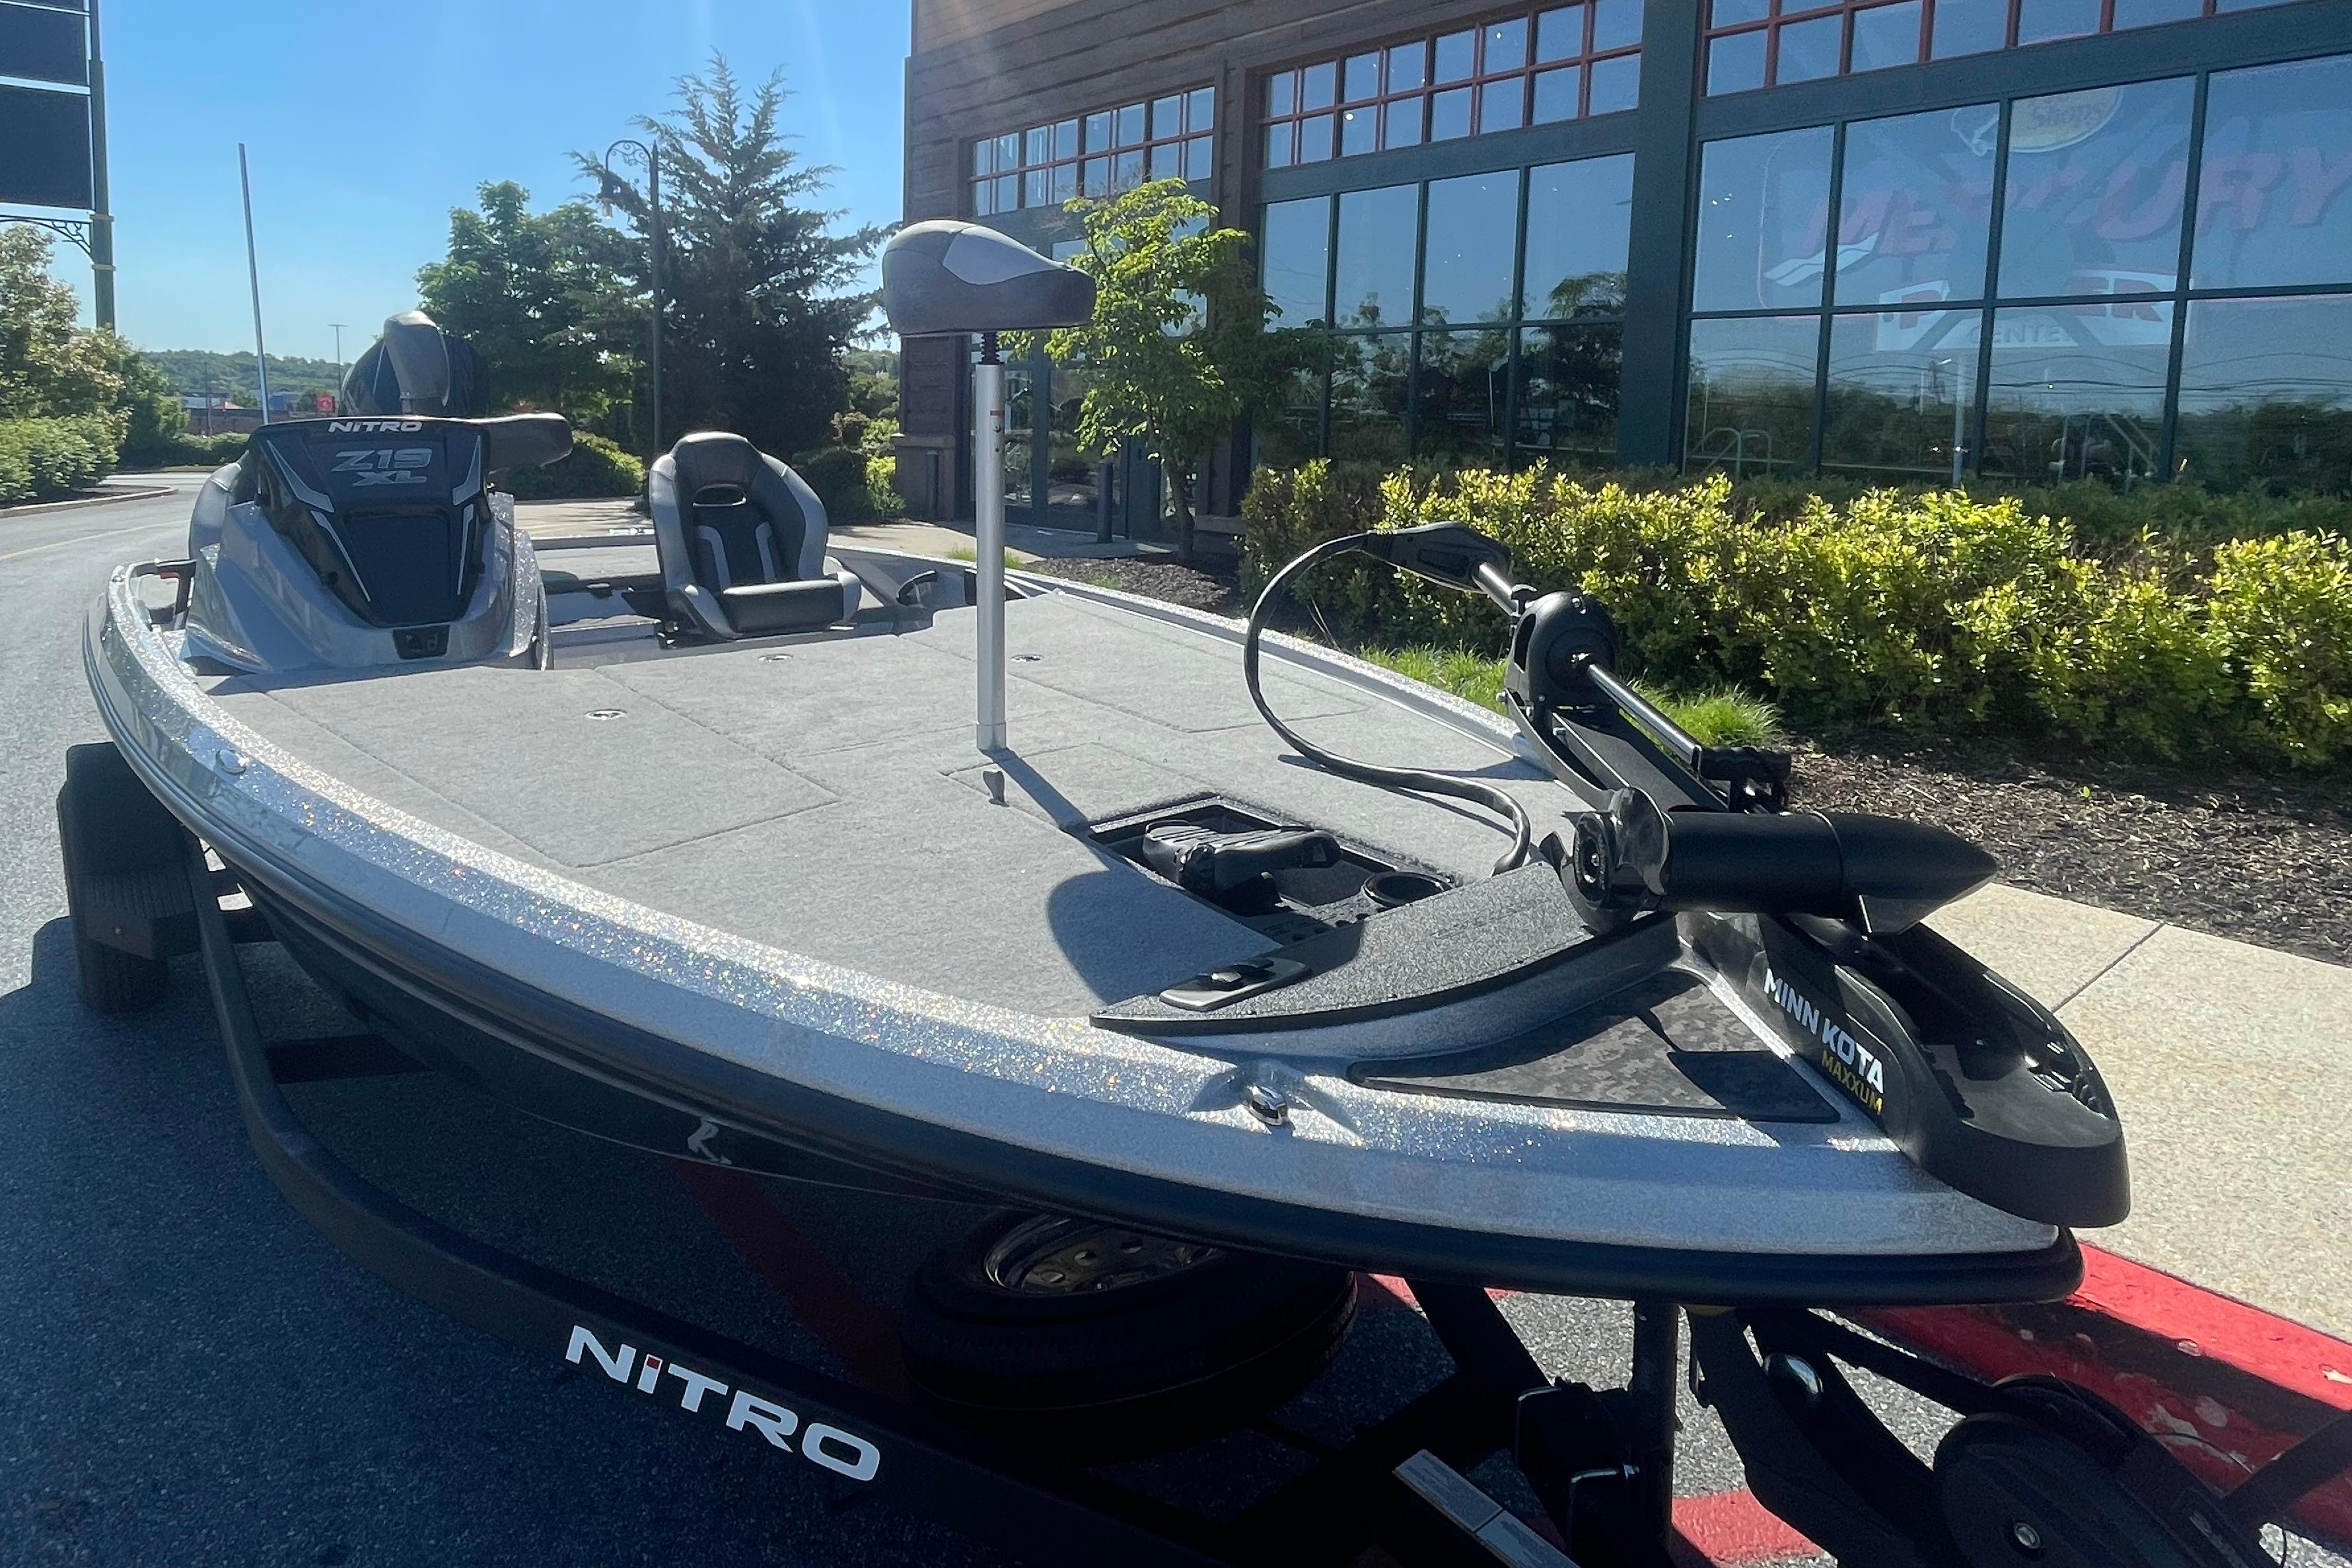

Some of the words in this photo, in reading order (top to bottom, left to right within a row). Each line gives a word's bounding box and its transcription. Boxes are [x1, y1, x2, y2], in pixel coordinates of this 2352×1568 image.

[1899, 276, 2164, 331] PER
[328, 421, 423, 433] NITRO
[332, 448, 433, 472] Z19
[353, 470, 427, 487] XL
[1764, 968, 1820, 1035] MINN
[1822, 1017, 1884, 1094] KOTA
[1821, 1050, 1883, 1116] MAXXUM
